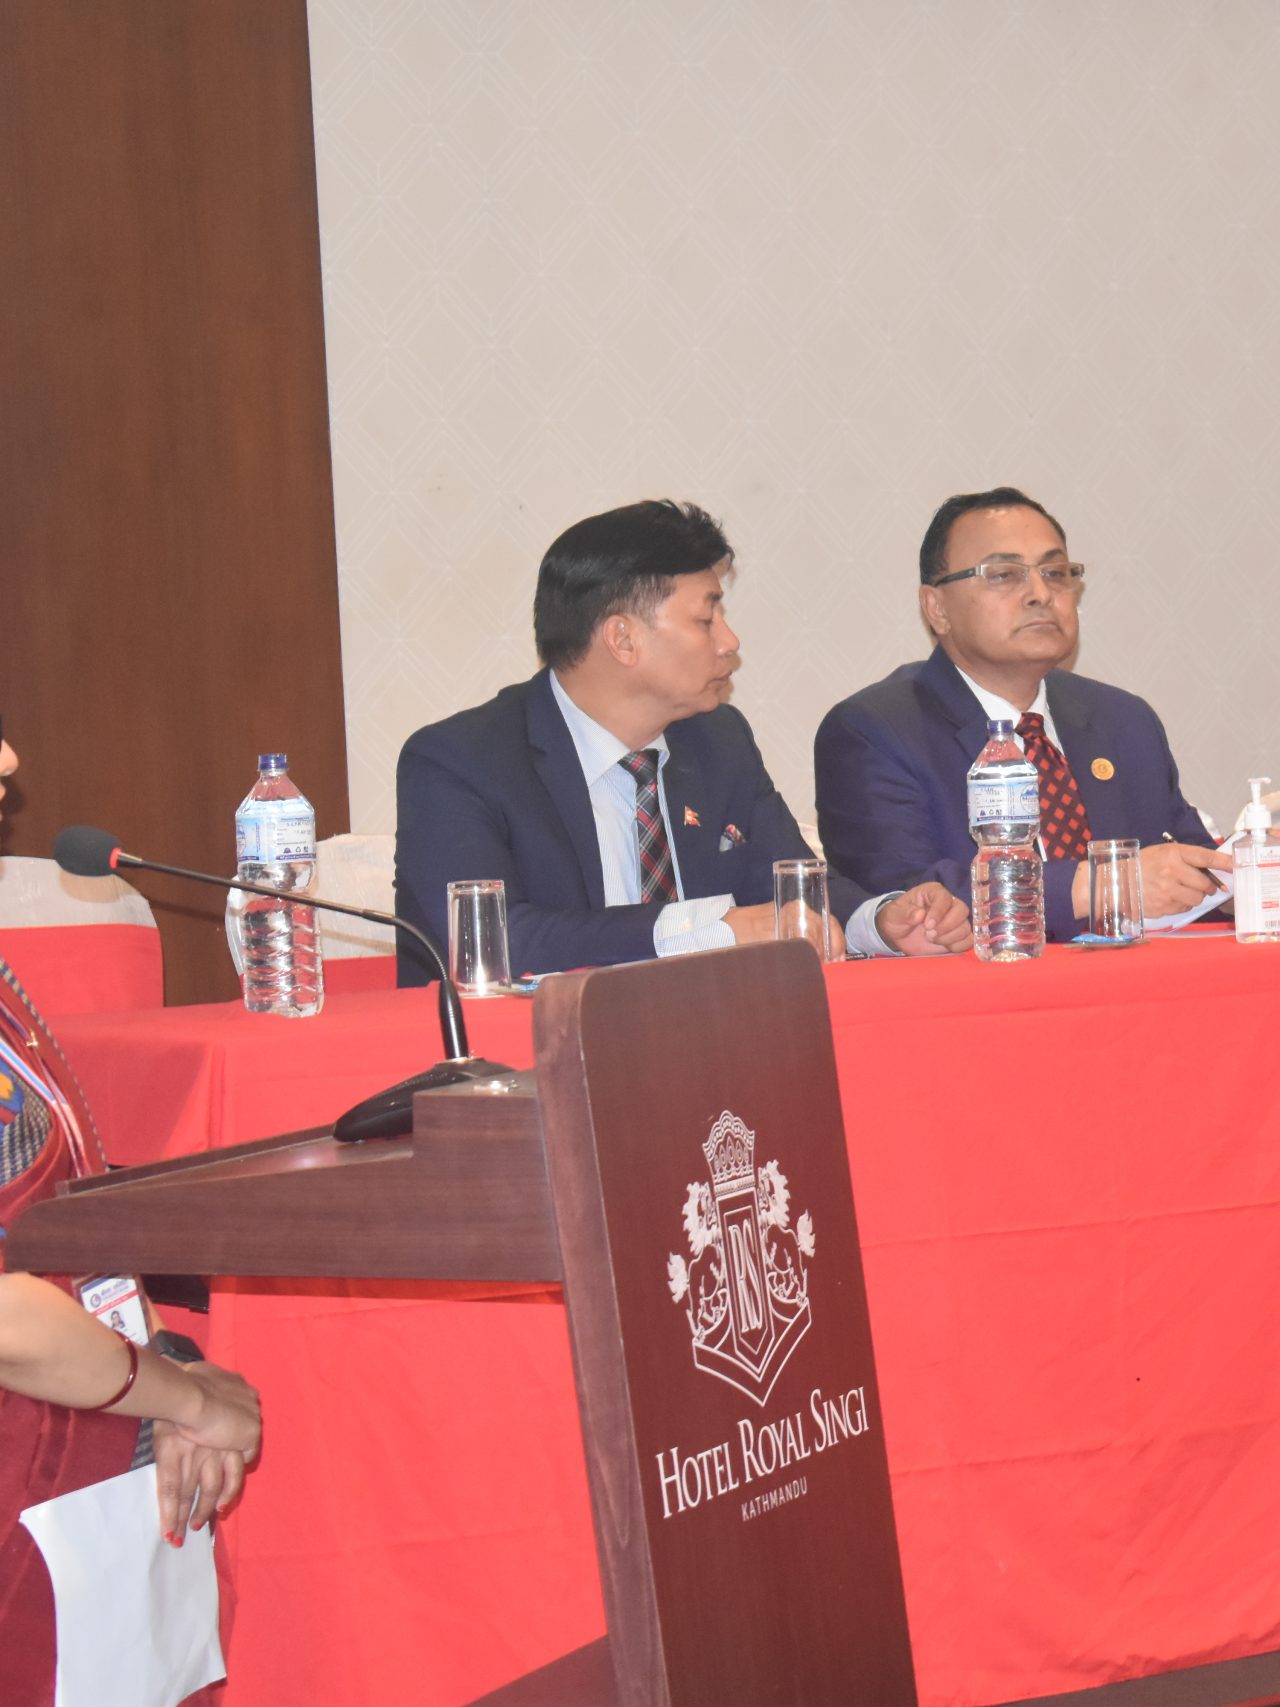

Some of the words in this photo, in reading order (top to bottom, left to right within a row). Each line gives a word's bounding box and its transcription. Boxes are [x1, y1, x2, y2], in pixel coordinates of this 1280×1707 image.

[728, 1219, 763, 1333] RS
[655, 1442, 740, 1518] HOTEL
[737, 1411, 811, 1484] ROYAL
[810, 1386, 870, 1453] SINGI
[741, 1476, 808, 1521] KATHMANDU
